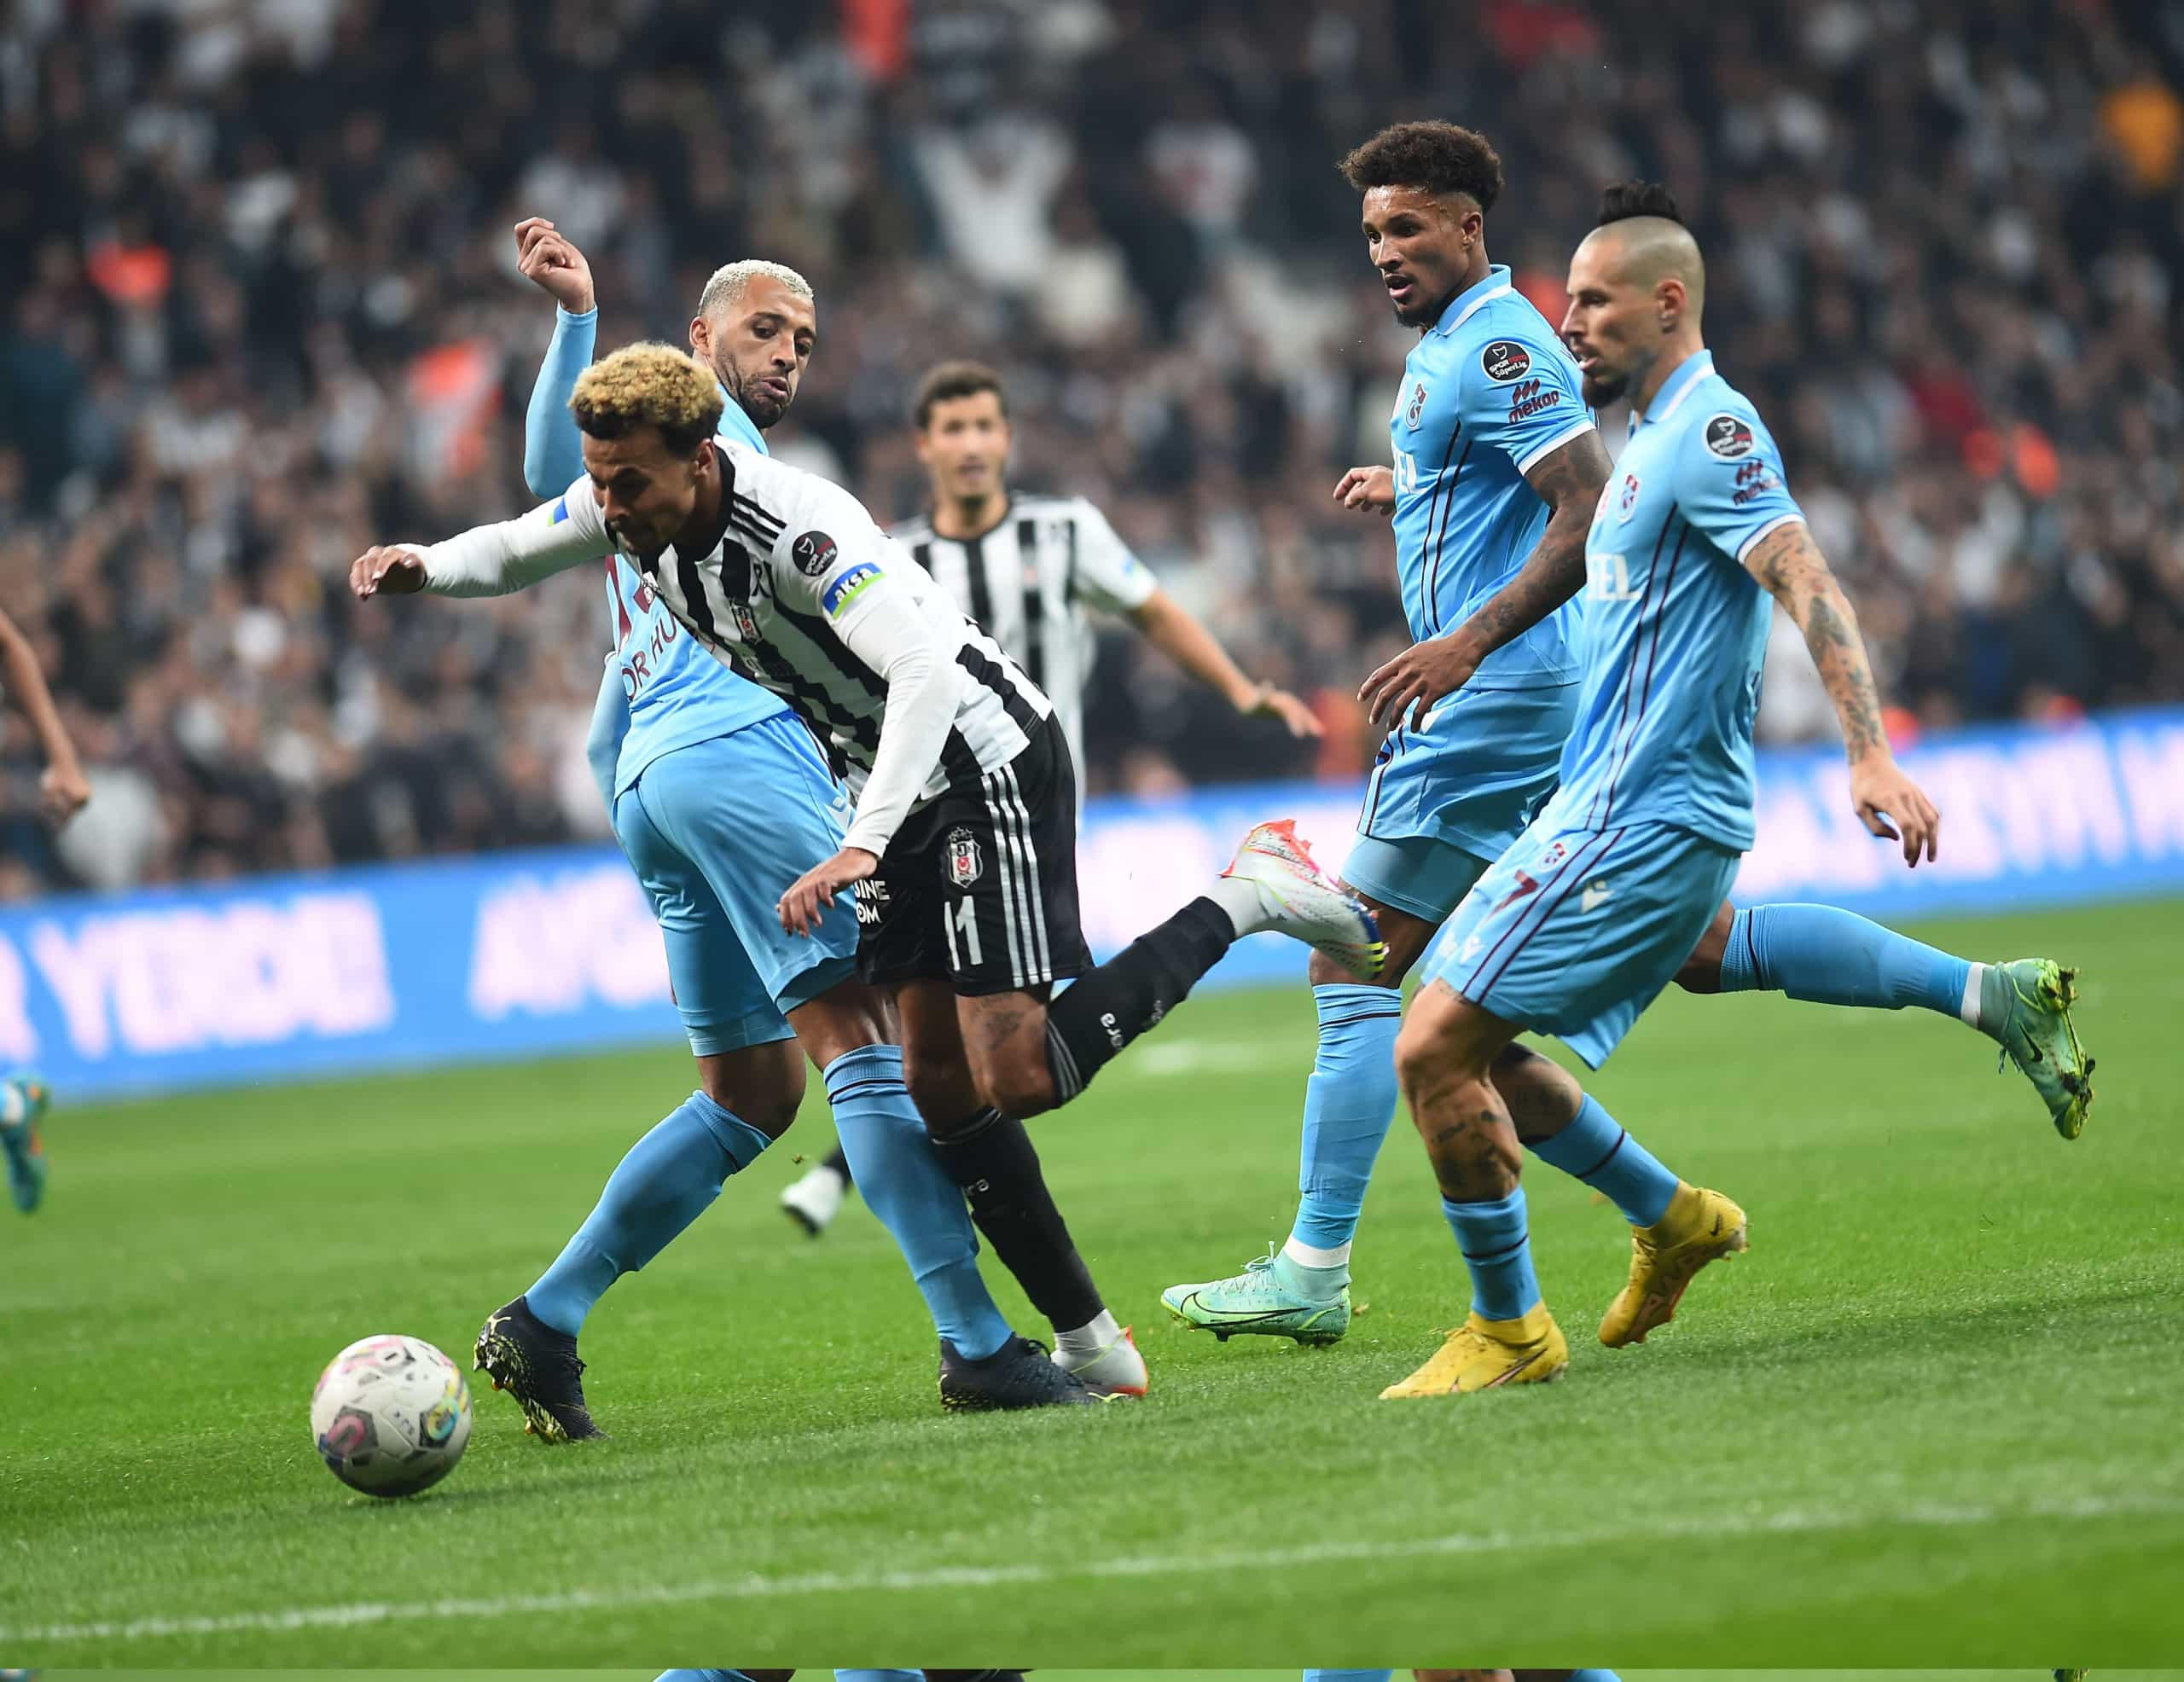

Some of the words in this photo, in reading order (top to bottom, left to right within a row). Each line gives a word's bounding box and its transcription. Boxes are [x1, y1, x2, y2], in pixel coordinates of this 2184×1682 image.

[1508, 390, 1560, 424] mekap
[834, 567, 874, 602] aksa
[944, 896, 983, 971] 11
